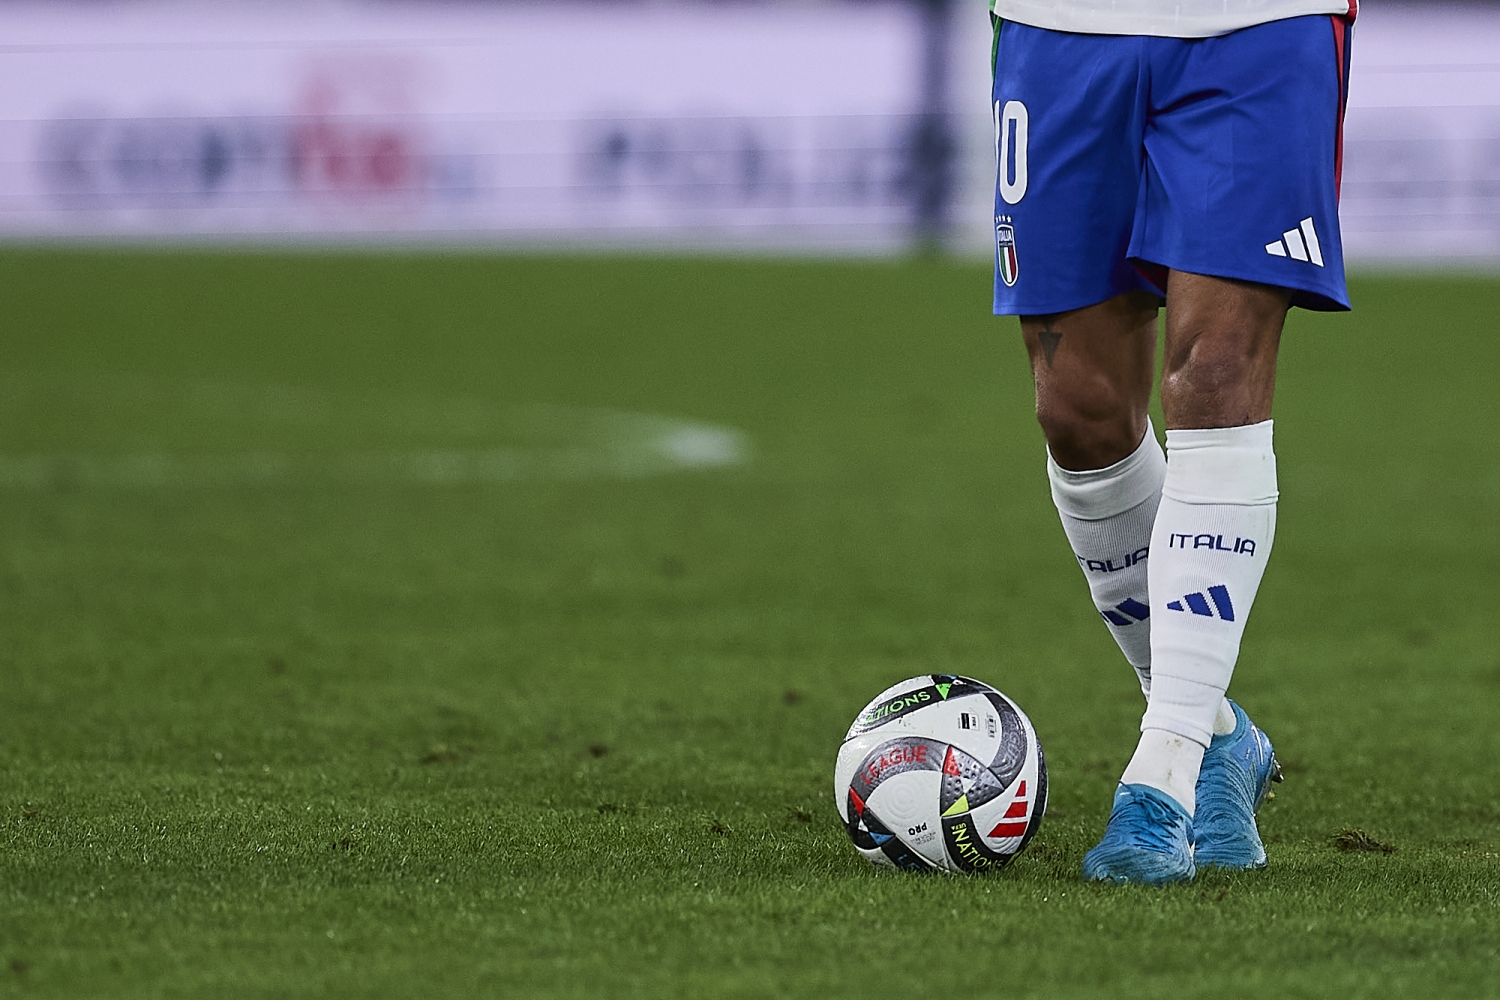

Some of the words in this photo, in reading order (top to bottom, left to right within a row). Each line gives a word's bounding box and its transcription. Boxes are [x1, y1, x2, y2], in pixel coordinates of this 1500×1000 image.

[1168, 532, 1257, 558] ITALIA
[860, 745, 928, 785] LEAGUE
[908, 822, 928, 836] PRO
